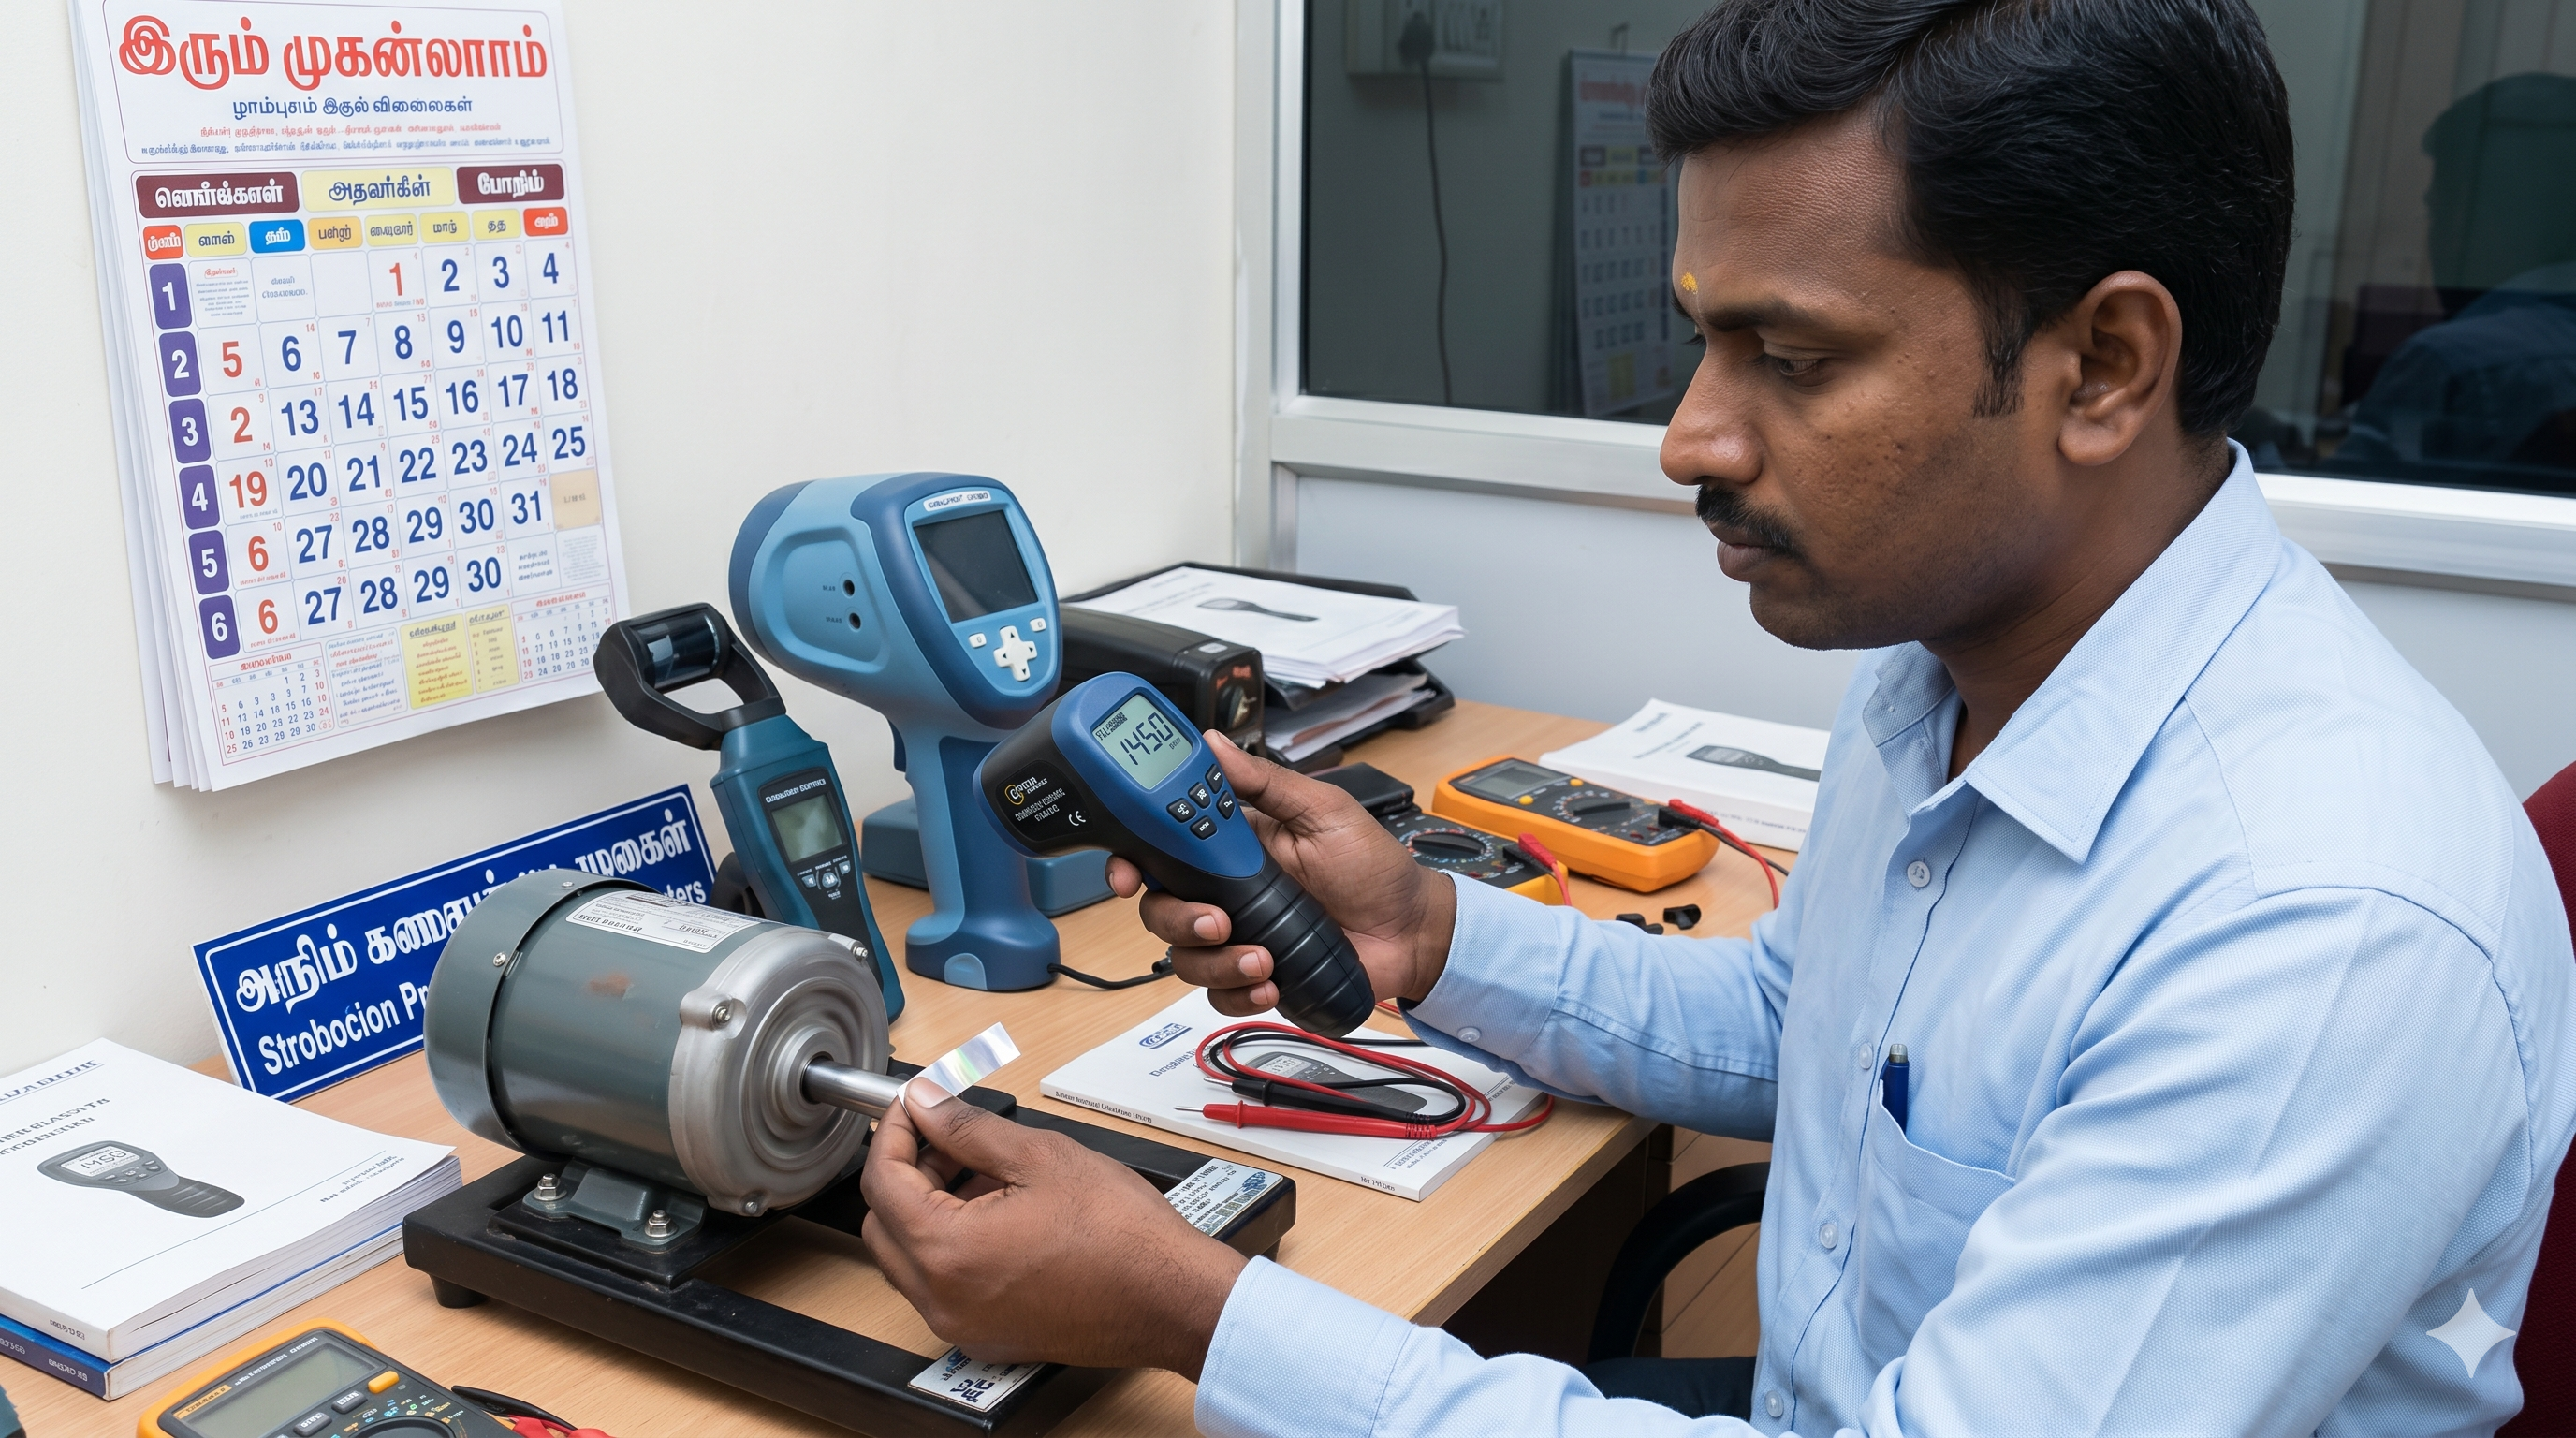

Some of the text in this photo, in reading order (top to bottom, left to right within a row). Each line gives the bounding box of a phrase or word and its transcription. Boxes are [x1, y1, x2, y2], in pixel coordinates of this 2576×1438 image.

[119, 15, 270, 91] இரும்
[161, 281, 176, 312] 1
[389, 263, 402, 296] 1
[442, 259, 460, 292] 2
[493, 256, 509, 288] 3
[543, 253, 559, 284] 4
[171, 311, 568, 380] 2 5 6 7 8 9 10 11
[181, 367, 578, 447] 3 2 13 14 15 16 17 18
[191, 425, 587, 512] 4 19 20 21 22 23 24 25
[201, 490, 542, 579] 5 6 27 28 29 30 31
[211, 611, 228, 642] 6
[257, 598, 279, 635] 6
[304, 586, 343, 626] 27
[359, 576, 399, 615] 28
[413, 565, 450, 604] 29
[466, 556, 502, 593] 30
[227, 744, 237, 754] 25
[242, 740, 253, 749] 26
[306, 723, 315, 732] 30
[239, 700, 243, 709] 6
[256, 723, 267, 732] 20
[288, 714, 298, 724] 22
[319, 707, 329, 716] 24
[1120, 712, 1174, 766] 1450
[258, 1001, 401, 1075] Strobocion
